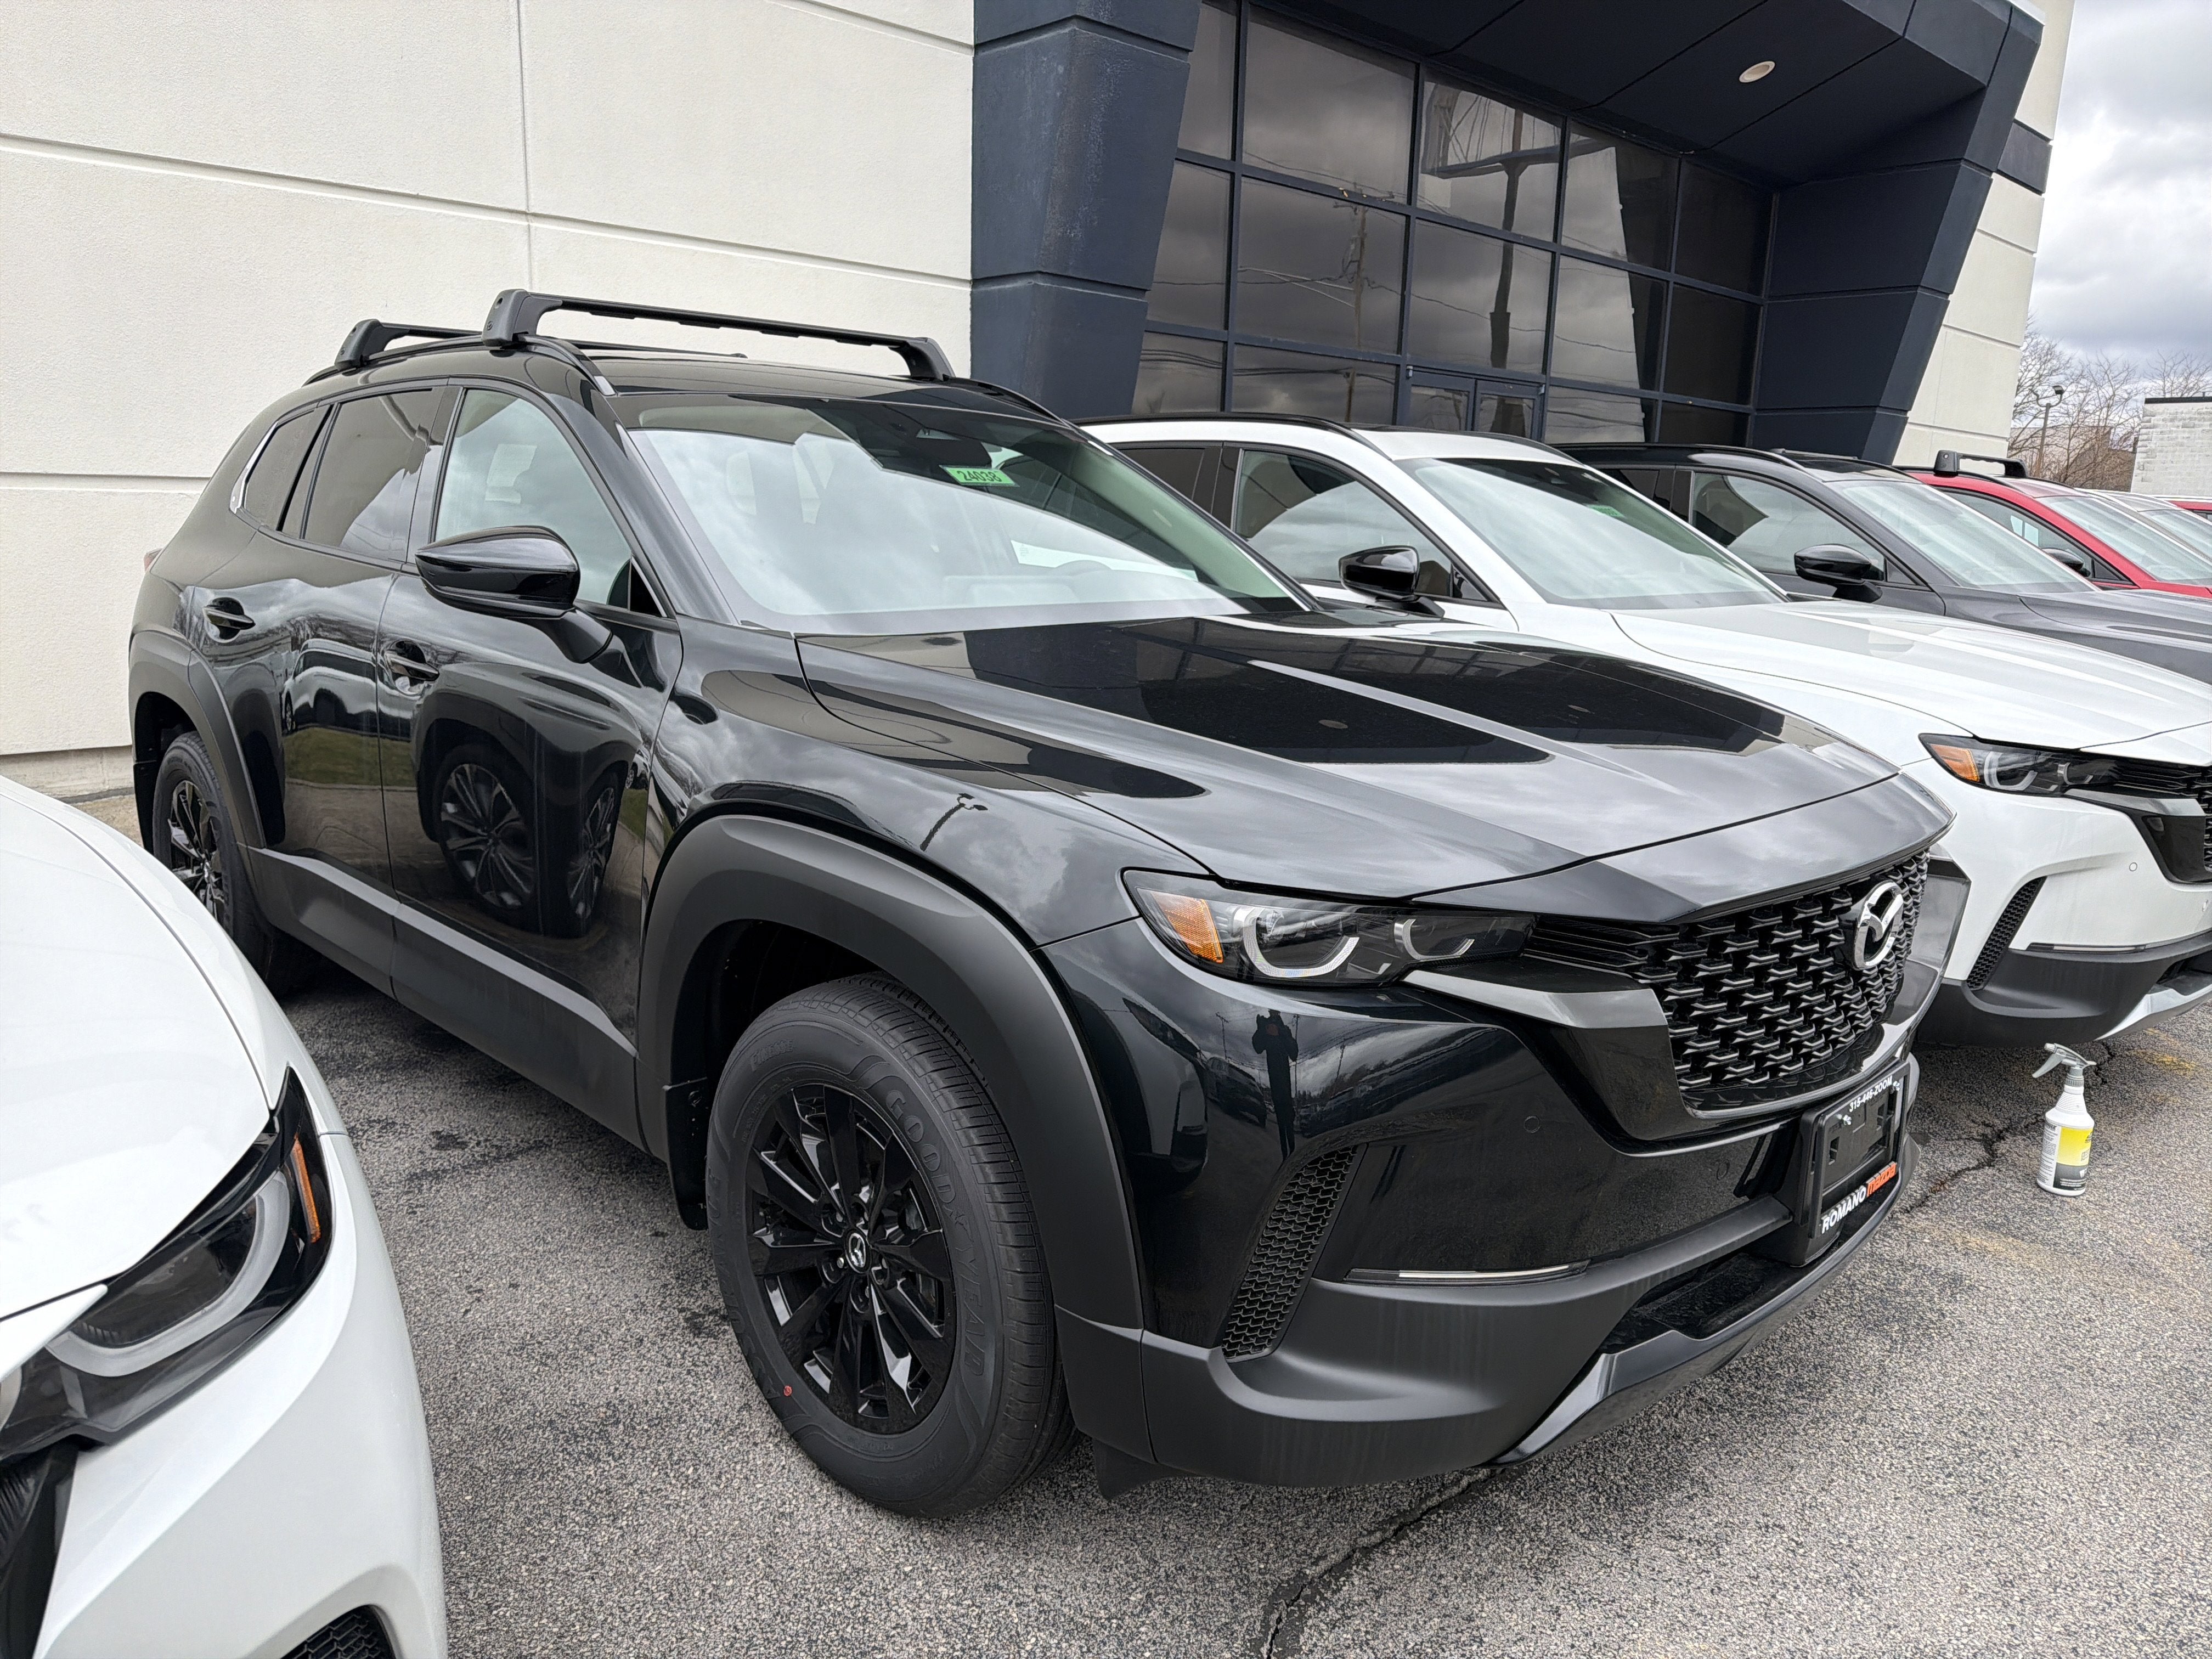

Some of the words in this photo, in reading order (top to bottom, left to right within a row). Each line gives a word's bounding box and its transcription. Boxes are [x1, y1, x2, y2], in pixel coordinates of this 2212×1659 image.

[957, 470, 1002, 482] 24038
[1849, 1075, 1893, 1113] 315-446-ZOOM
[1821, 1186, 1866, 1234] ROMANO
